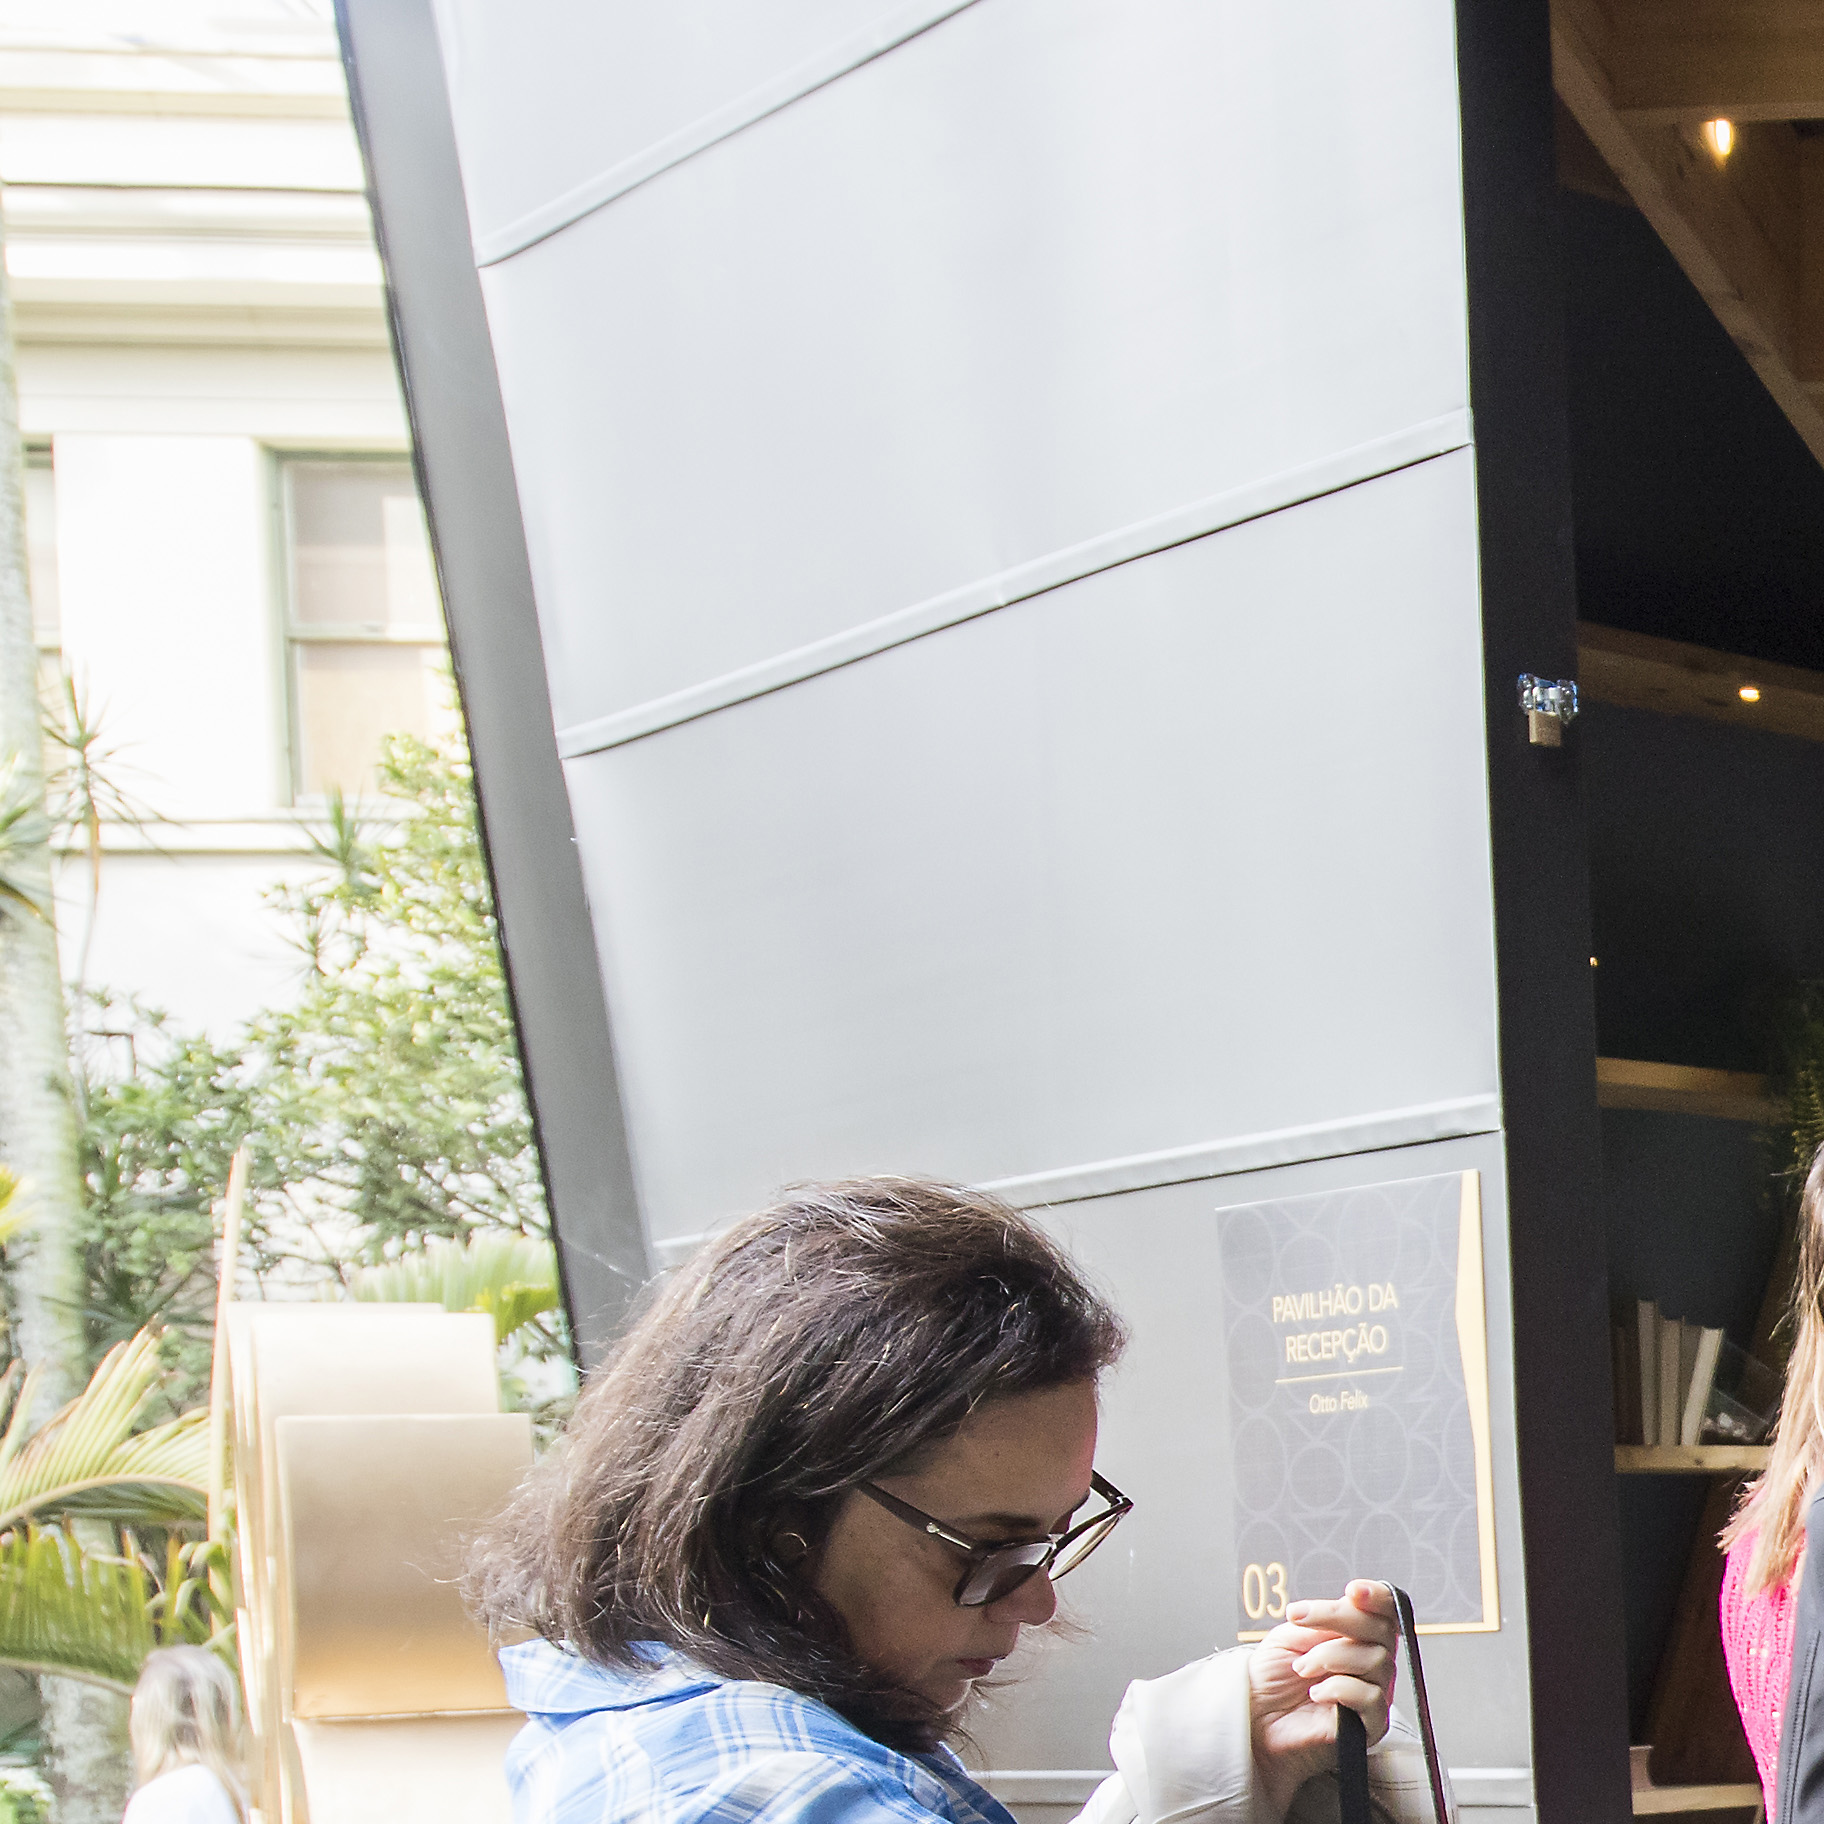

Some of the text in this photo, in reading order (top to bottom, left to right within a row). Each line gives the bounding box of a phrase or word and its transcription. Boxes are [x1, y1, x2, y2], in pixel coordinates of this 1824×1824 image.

[1272, 1282, 1399, 1323] PAVILHÃO DA
[1285, 1322, 1388, 1363] RECEPÇÃO
[1309, 1389, 1369, 1414] Otto Felix
[1242, 1561, 1288, 1620] 03
